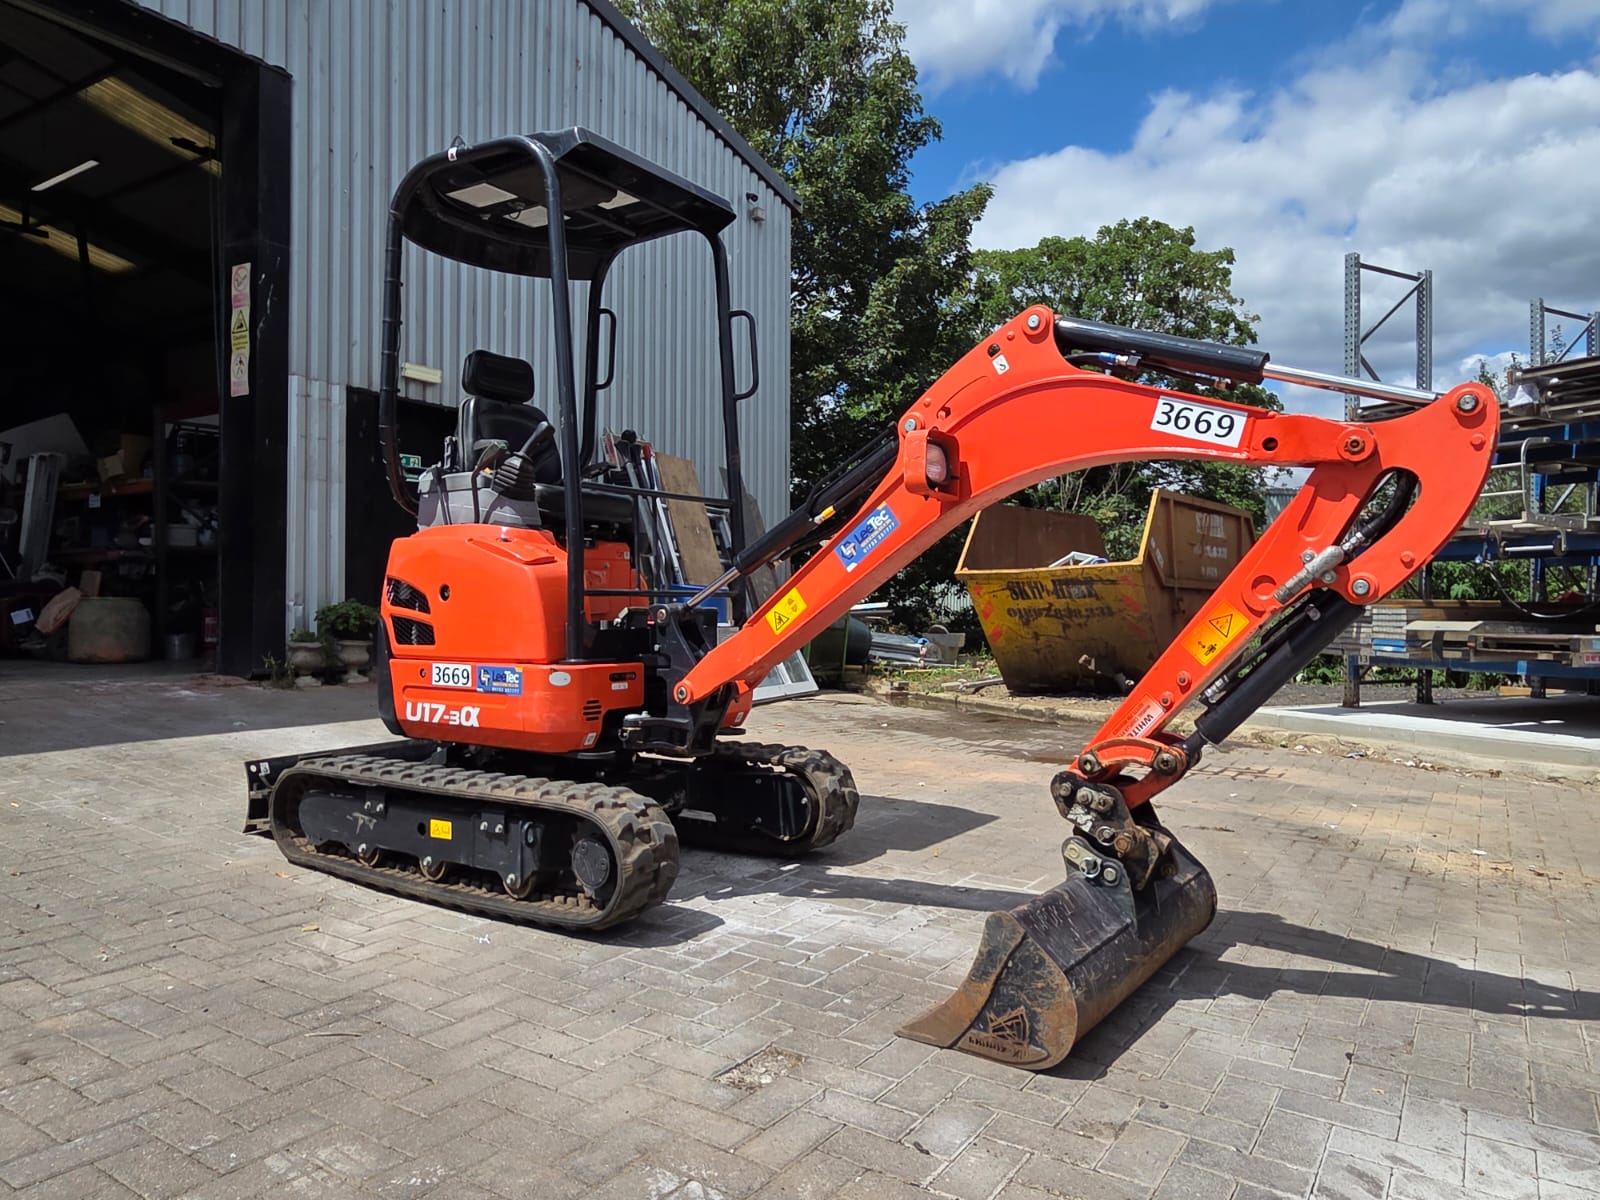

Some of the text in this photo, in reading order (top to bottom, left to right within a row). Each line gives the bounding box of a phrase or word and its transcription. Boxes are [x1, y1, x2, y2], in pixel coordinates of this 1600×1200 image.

[1156, 402, 1235, 438] 3669
[854, 510, 889, 544] LeeTec
[434, 666, 470, 686] 3669
[492, 670, 520, 684] LeeTec
